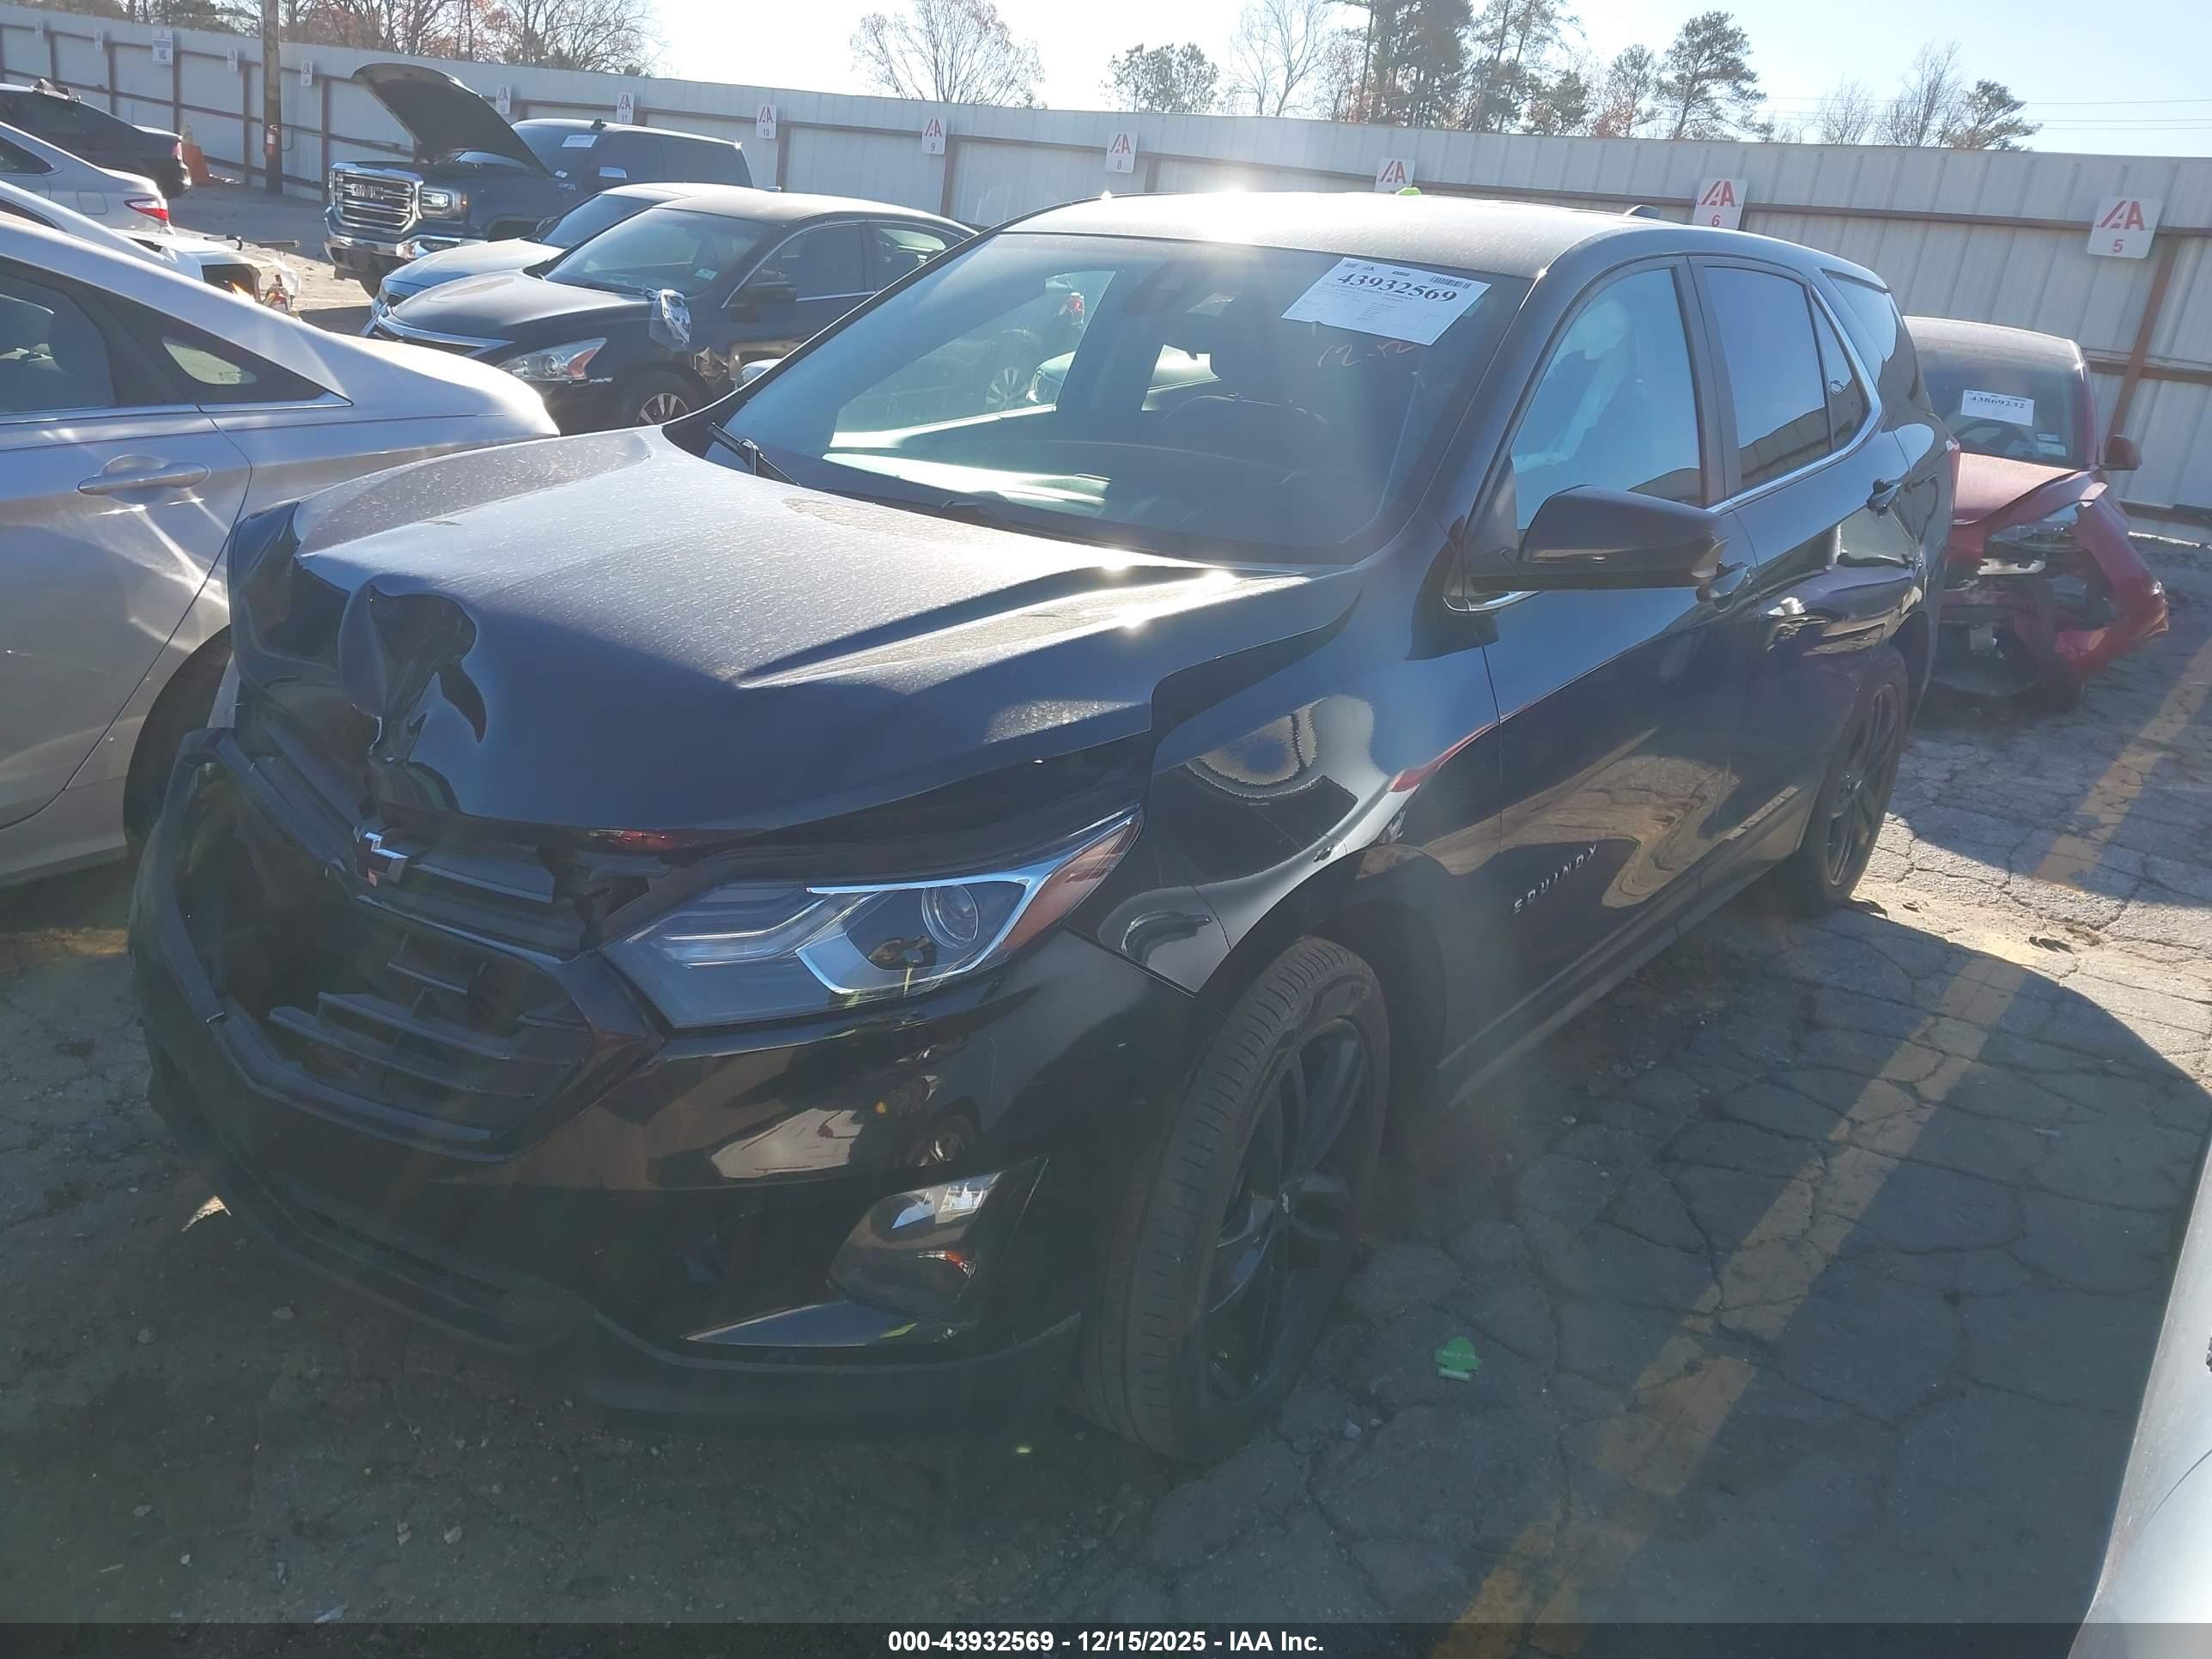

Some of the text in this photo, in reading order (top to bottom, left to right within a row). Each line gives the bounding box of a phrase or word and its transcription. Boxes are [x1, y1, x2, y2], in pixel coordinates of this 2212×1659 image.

[763, 128, 770, 137] 10
[930, 142, 936, 152] 9
[1117, 159, 1123, 170] 8
[350, 183, 384, 200] GMC
[1711, 214, 1721, 227] 6
[2112, 238, 2125, 253] 5
[1337, 273, 1457, 302] 43932569
